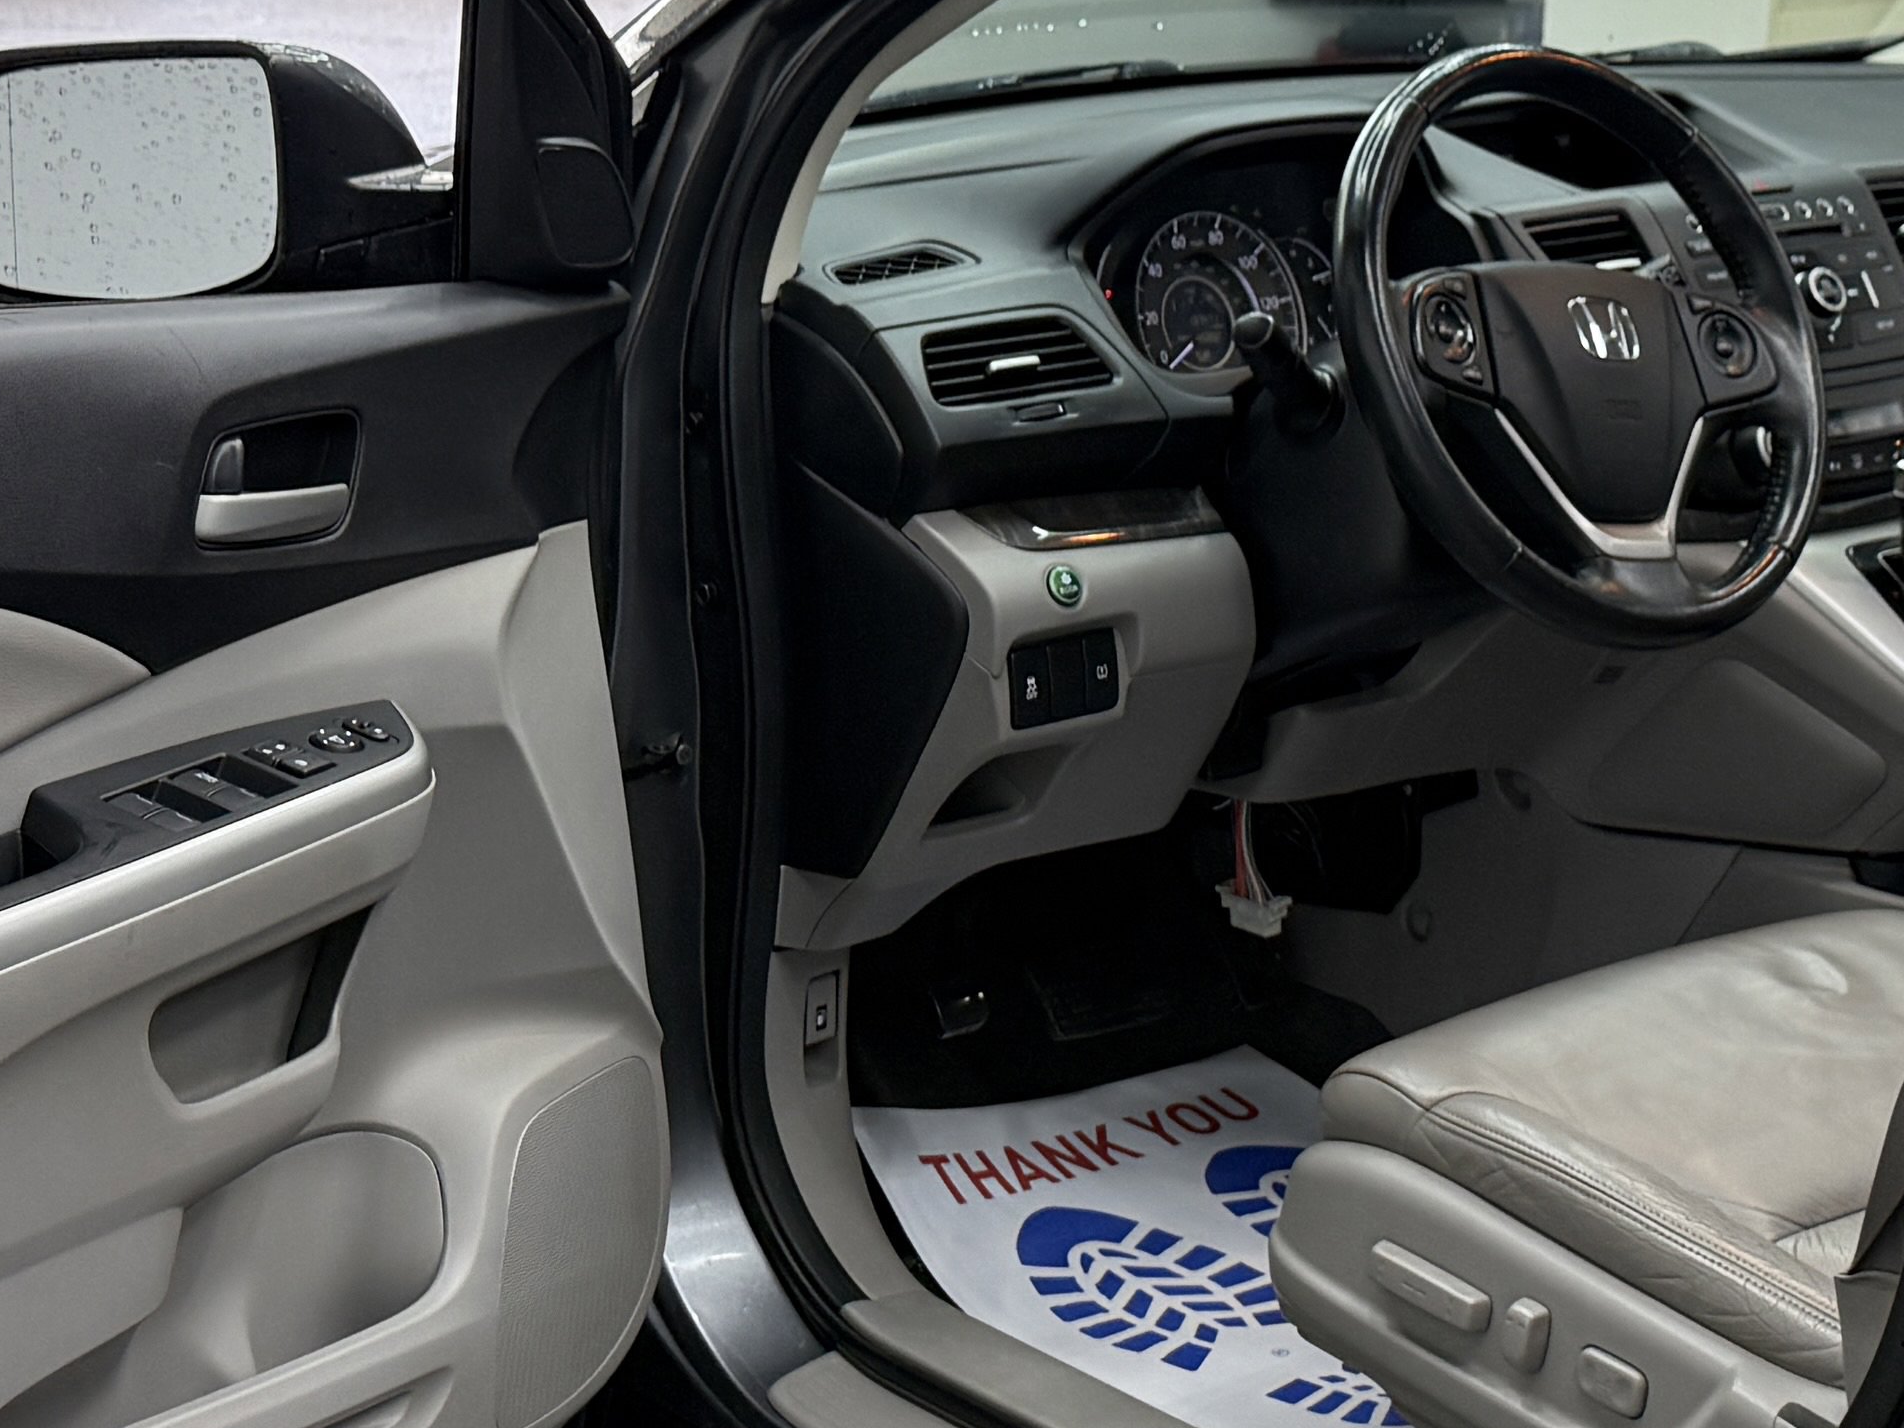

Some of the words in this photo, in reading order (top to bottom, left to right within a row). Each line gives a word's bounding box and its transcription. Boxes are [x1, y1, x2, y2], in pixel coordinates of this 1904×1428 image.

[1171, 234, 1186, 250] 60
[1208, 230, 1224, 245] 80
[1238, 255, 1258, 270] 100
[1148, 263, 1162, 278] 40
[1145, 311, 1159, 325] 20
[1160, 350, 1168, 363] 0
[917, 1123, 1145, 1205] THANK
[1125, 1086, 1261, 1146] YOU
